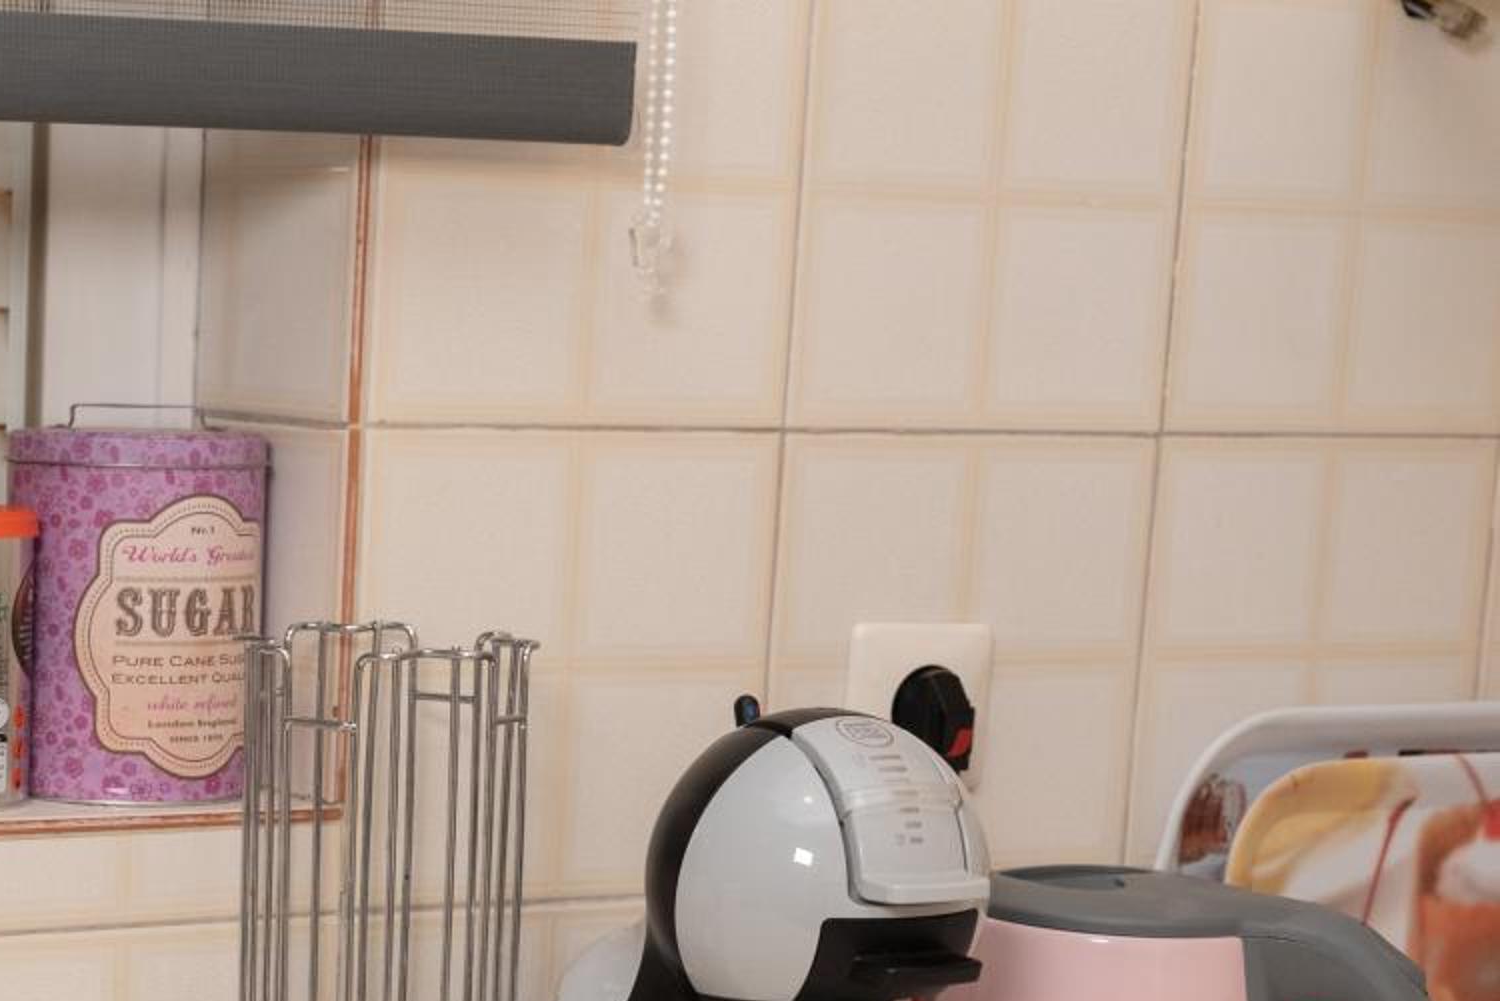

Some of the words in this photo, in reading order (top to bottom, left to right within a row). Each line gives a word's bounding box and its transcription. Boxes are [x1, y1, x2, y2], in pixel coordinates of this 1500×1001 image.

[112, 655, 164, 667] PURE
[169, 654, 216, 667] CANE
[111, 673, 207, 685] EXCELLENT
